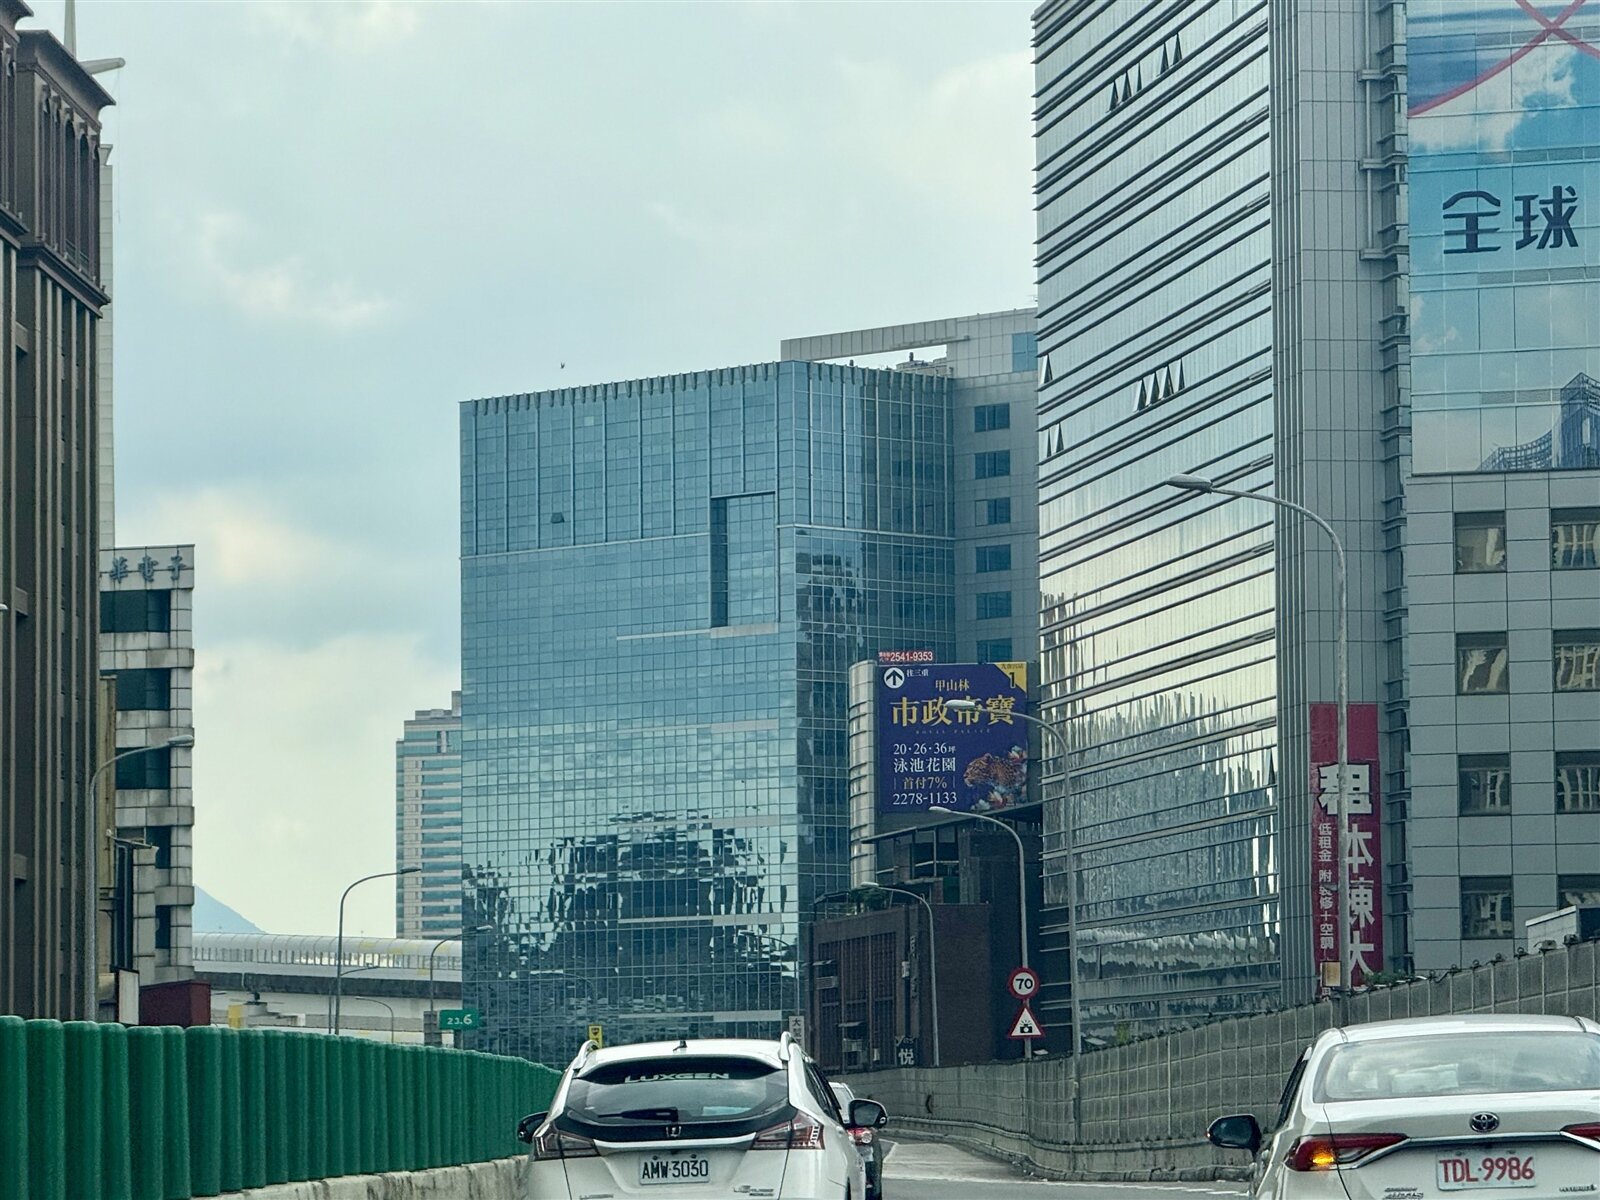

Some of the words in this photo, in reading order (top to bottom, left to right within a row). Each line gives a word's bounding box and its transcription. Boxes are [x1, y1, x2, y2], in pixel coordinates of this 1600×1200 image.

[1443, 186, 1579, 254] 全球
[890, 651, 933, 662] 2541-9353
[935, 678, 970, 692] 甲山林
[893, 757, 956, 773] 泳池花園
[903, 776, 948, 790] 首付7%
[1317, 764, 1373, 815] 租
[892, 791, 958, 805] 2278-1133
[1318, 823, 1333, 862] 低租金
[1015, 978, 1033, 990] 70
[624, 1072, 729, 1083] LUXGEN
